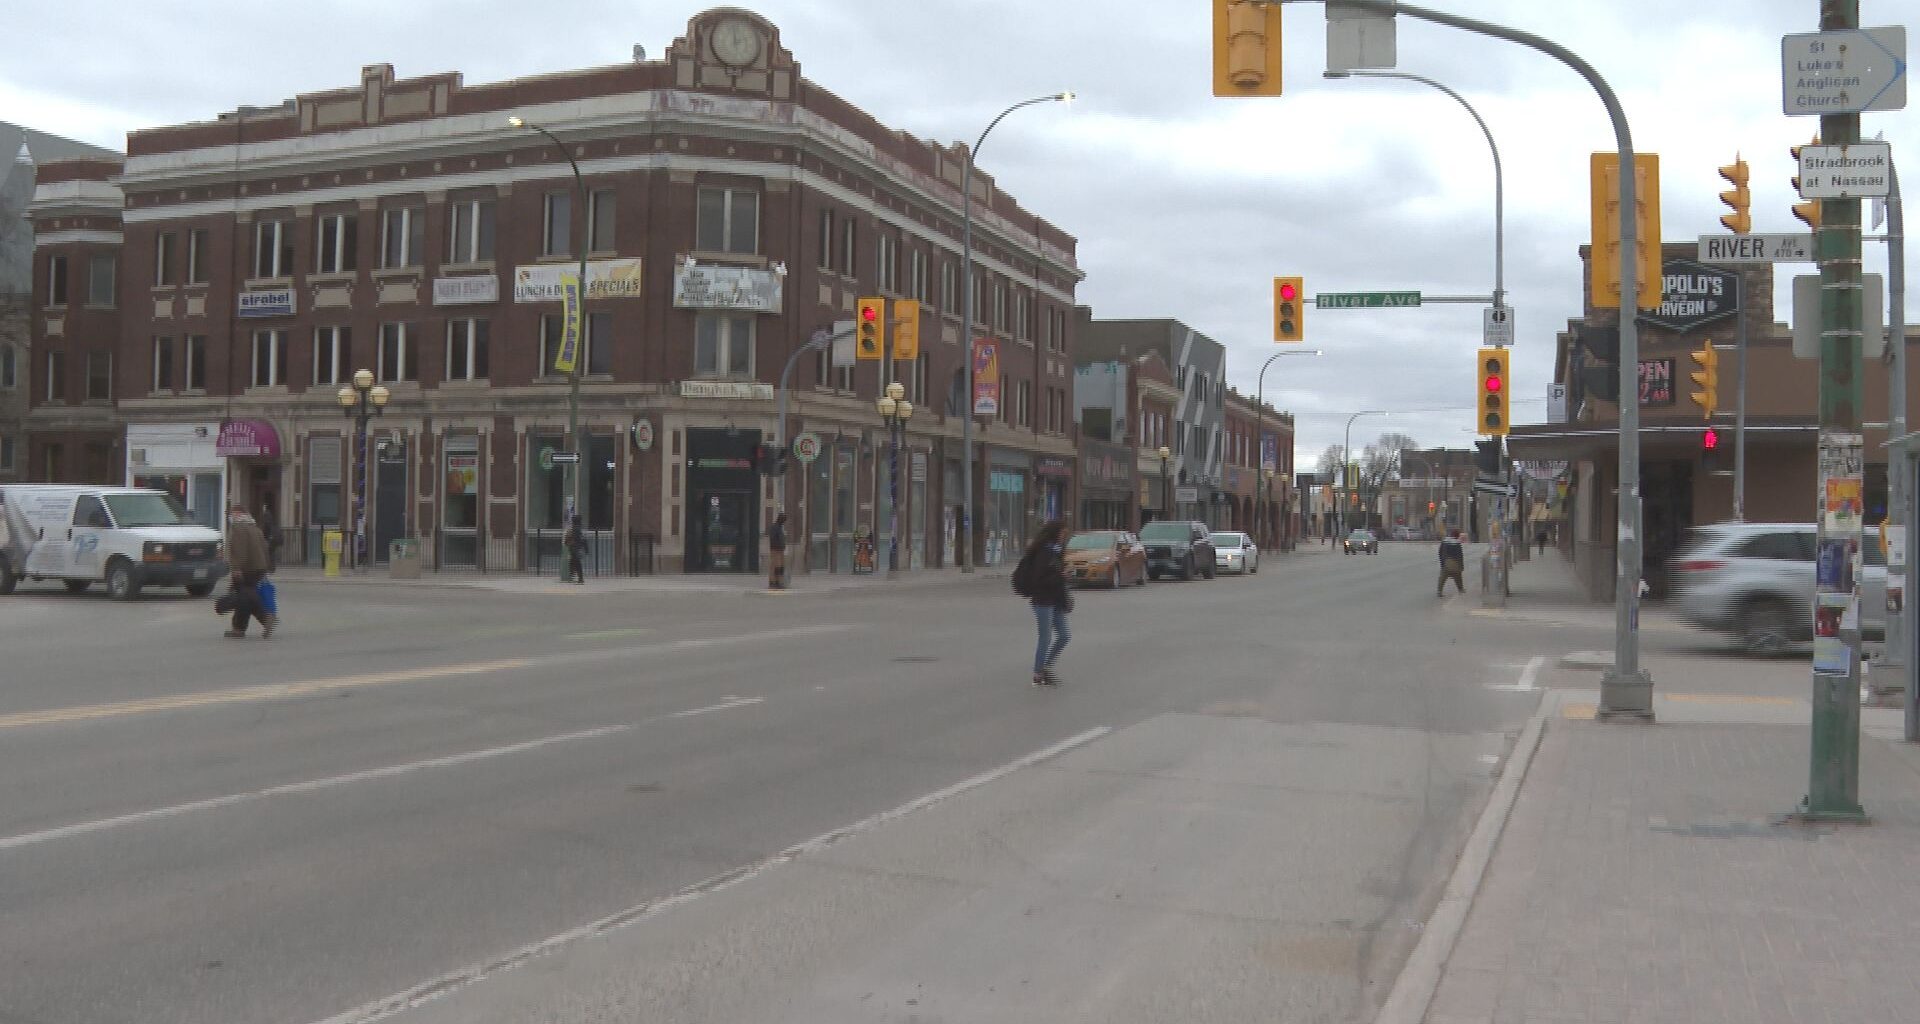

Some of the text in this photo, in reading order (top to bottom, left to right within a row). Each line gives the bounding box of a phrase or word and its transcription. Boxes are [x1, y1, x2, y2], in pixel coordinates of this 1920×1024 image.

[1809, 40, 1825, 54] St
[1797, 58, 1844, 72] Luke's
[1796, 76, 1861, 90] Anglican
[1796, 93, 1849, 108] Church
[1805, 154, 1885, 169] Stradbrook
[1806, 175, 1884, 188] at Nassau
[1708, 238, 1797, 260] RIVER AVE
[516, 283, 546, 298] LUNCH
[589, 279, 639, 295] SPECIALS
[1661, 274, 1723, 295] POLD'S
[241, 292, 289, 305] strobel
[1319, 294, 1419, 308] River Ave
[1637, 360, 1670, 382] PEN
